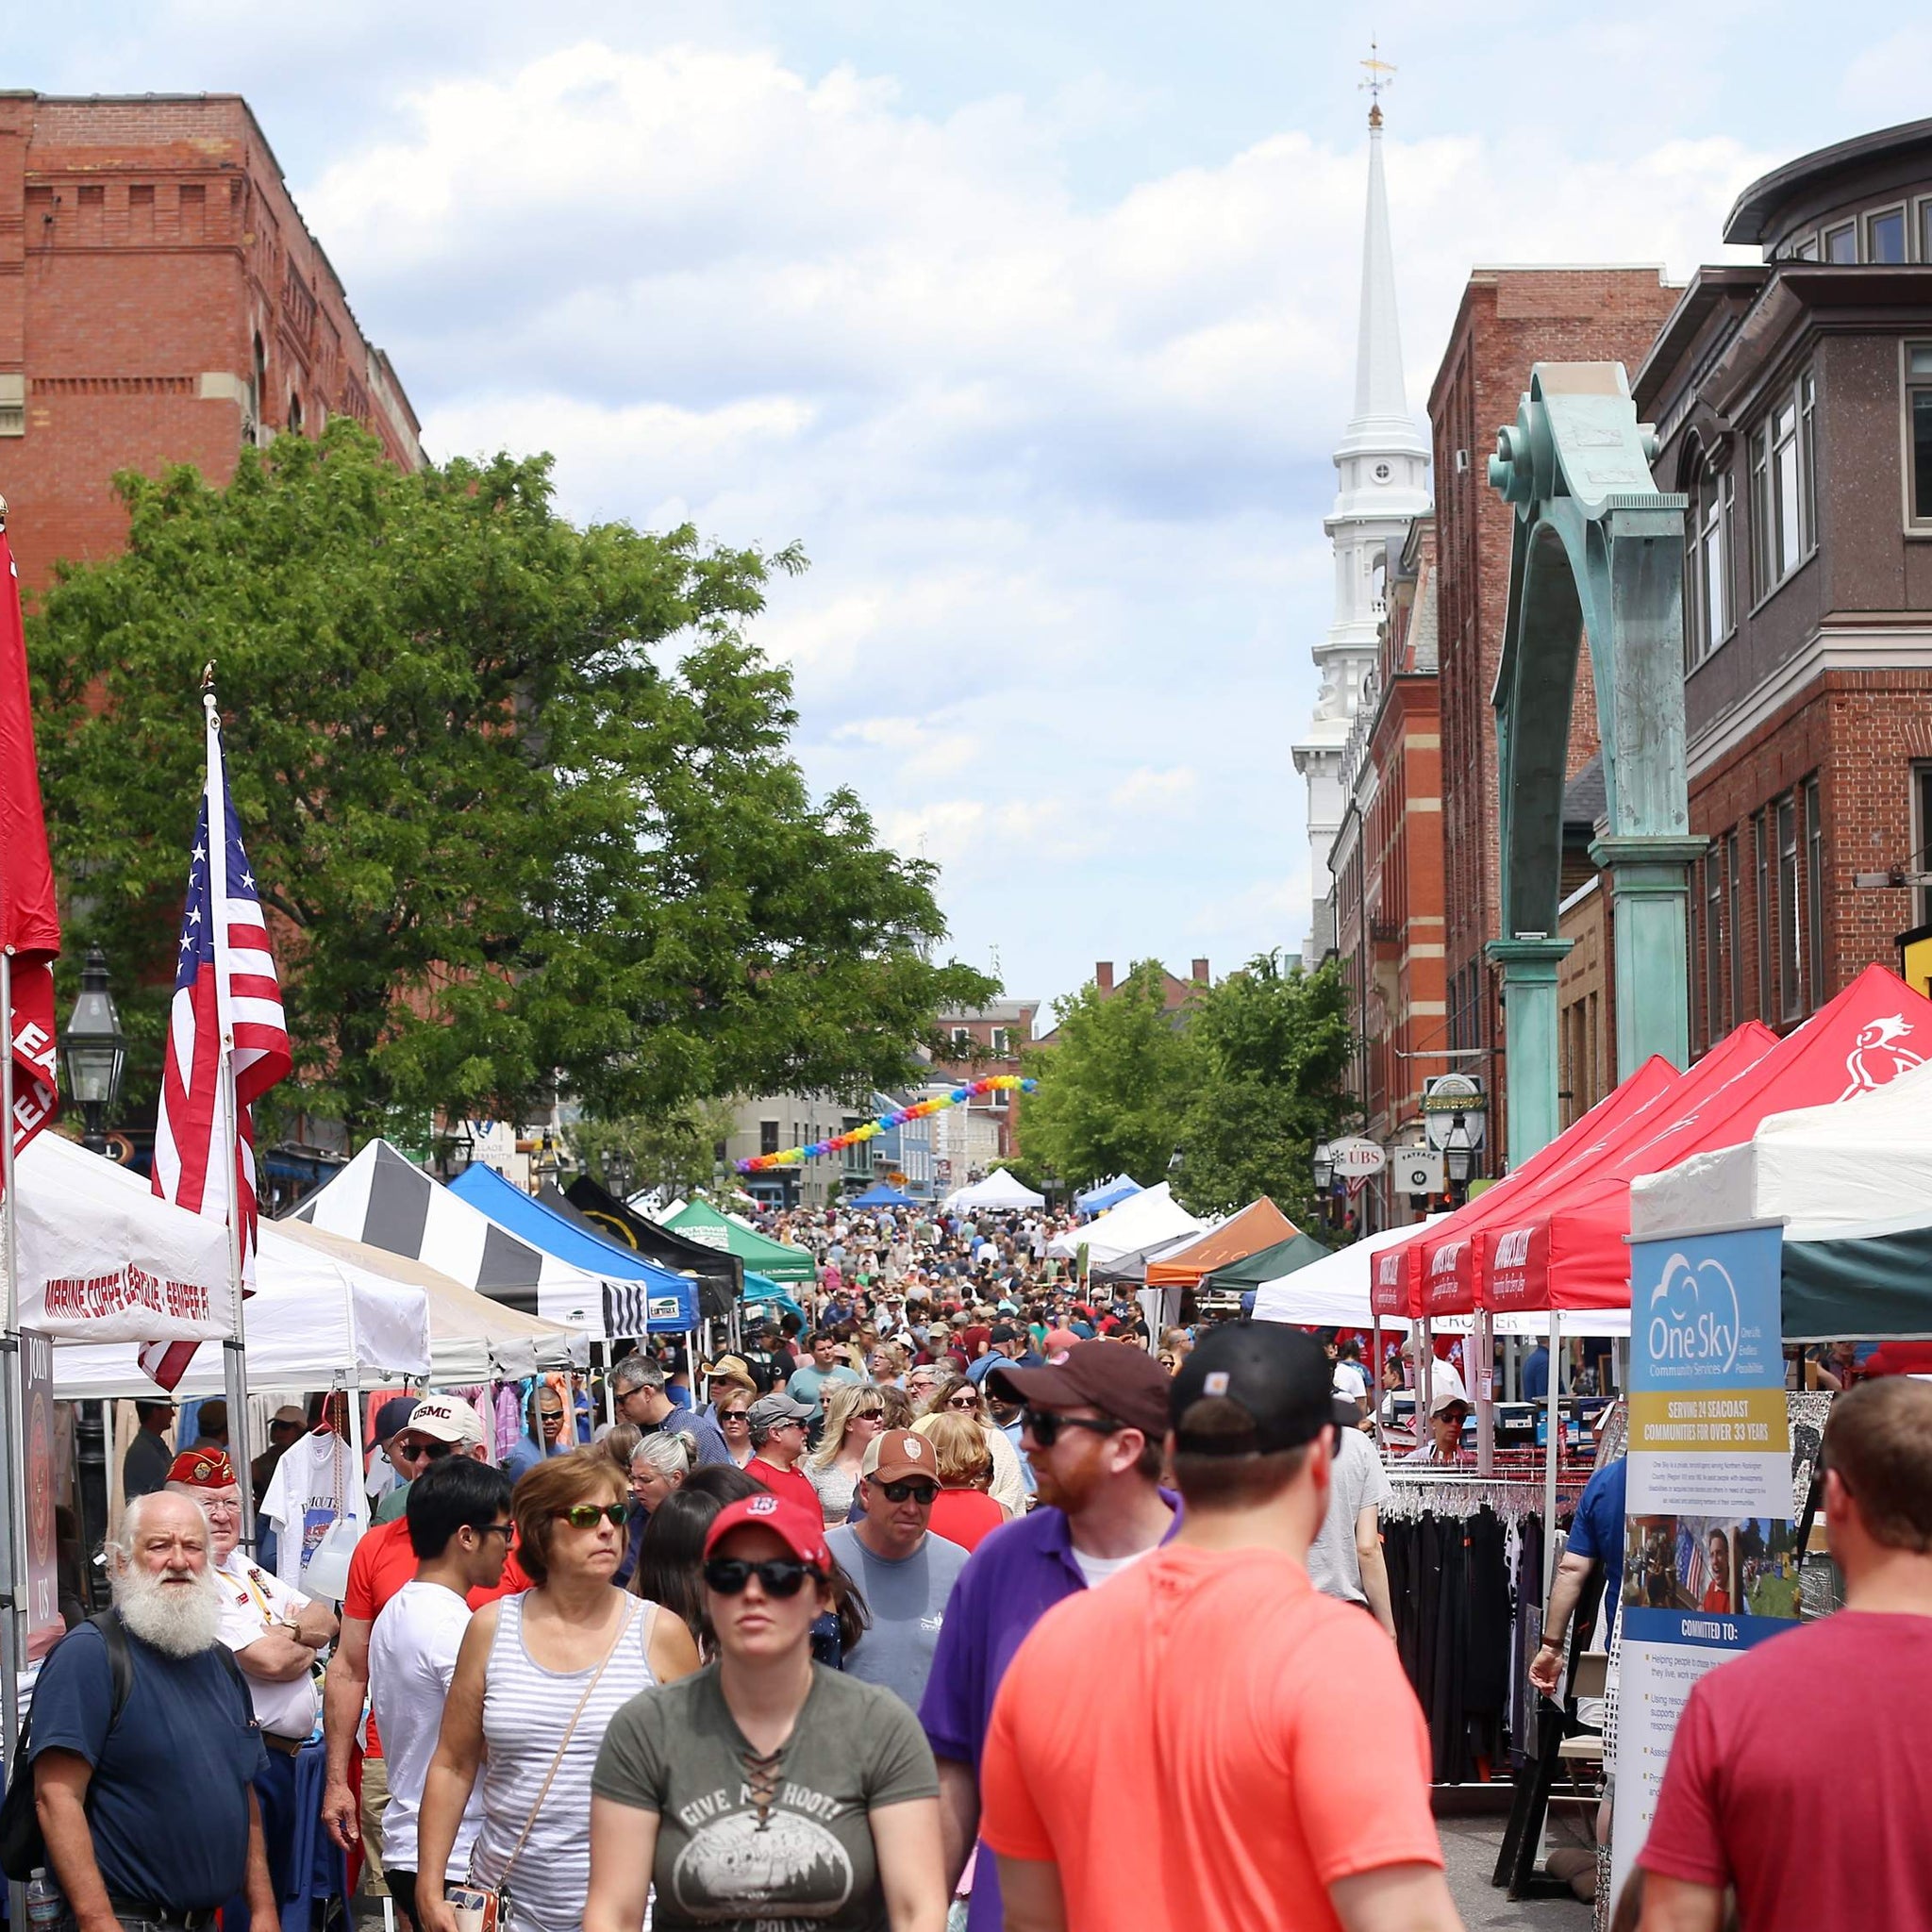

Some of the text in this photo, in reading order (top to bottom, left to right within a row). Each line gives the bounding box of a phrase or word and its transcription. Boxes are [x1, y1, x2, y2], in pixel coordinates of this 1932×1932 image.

[1349, 1150, 1380, 1164] UBS
[44, 1278, 92, 1319] MARINE
[87, 1273, 125, 1319] CORPS
[122, 1262, 163, 1314] LEAGUE
[166, 1280, 201, 1321] SEMPER
[1649, 1311, 1740, 1374] One Sky
[28, 1337, 47, 1390] JOIN
[1650, 1363, 1722, 1378] Community Services
[413, 1406, 452, 1421] USMC
[1668, 1400, 1749, 1418] SERVING 24 SEACOAST
[1644, 1423, 1768, 1441] COMMUNITIES FOR OVER 33 YEARS
[38, 1577, 50, 1621] US
[1681, 1619, 1739, 1641] COMMITTED TO:
[1651, 1654, 1673, 1667] Helping
[1650, 1693, 1668, 1707] Using
[1650, 1708, 1675, 1720] supports
[680, 1789, 732, 1827] GIVE
[782, 1781, 844, 1822] HOOT!
